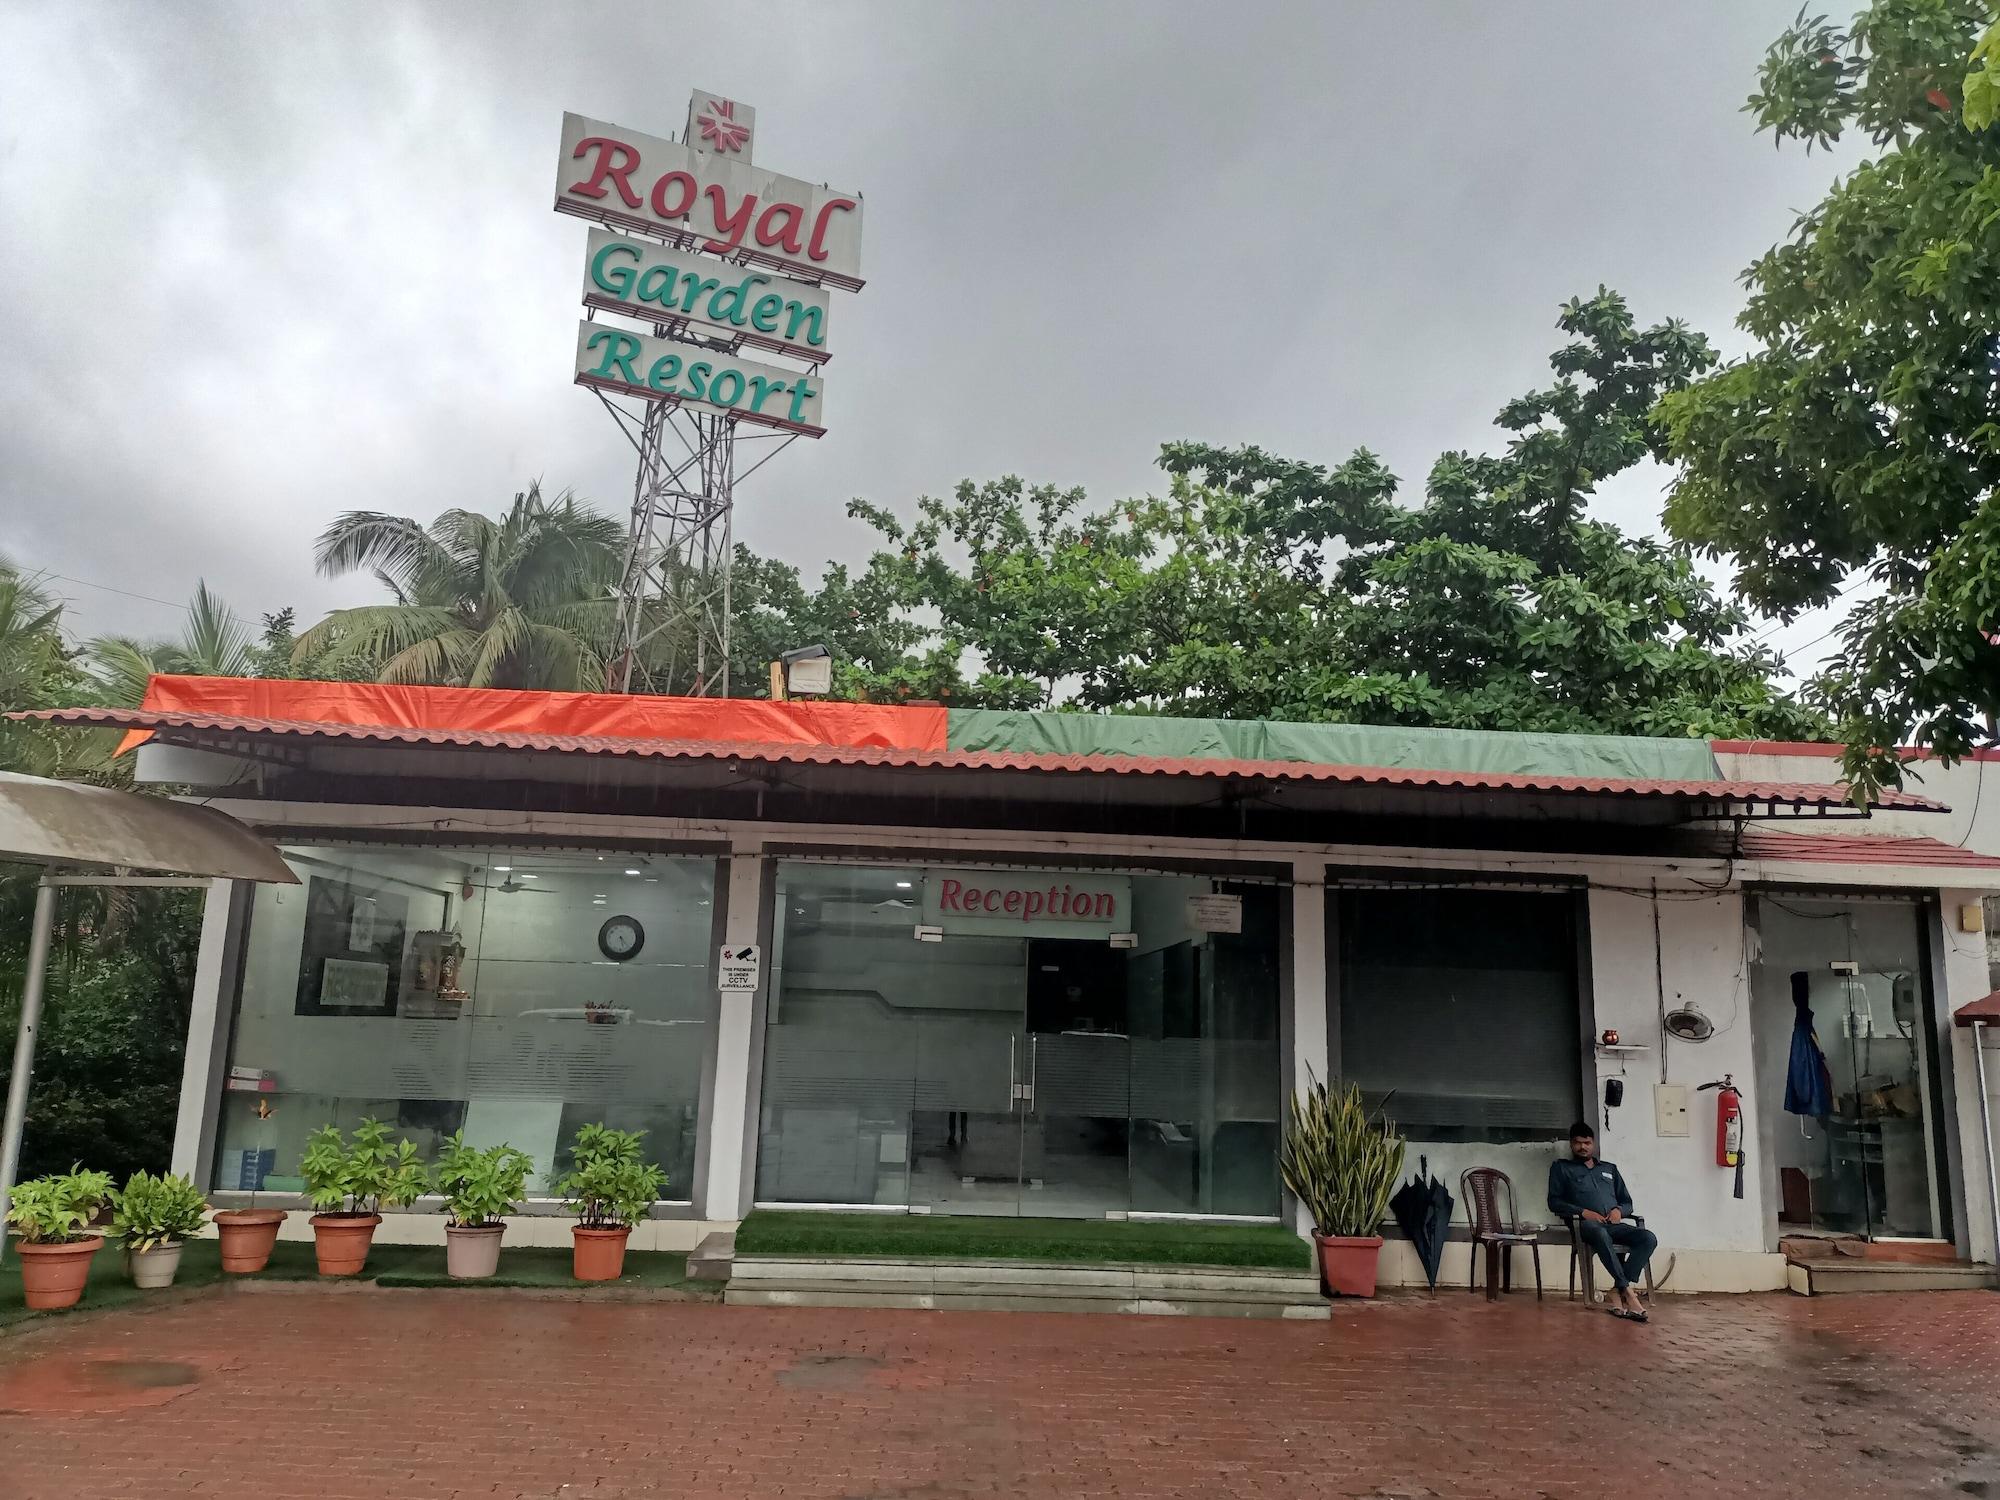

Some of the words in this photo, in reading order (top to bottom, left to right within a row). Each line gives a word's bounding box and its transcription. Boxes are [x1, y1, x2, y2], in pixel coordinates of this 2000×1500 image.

[569, 137, 857, 261] Royal
[591, 242, 825, 346] Garden
[586, 330, 817, 424] Resort
[939, 879, 1116, 923] Reception
